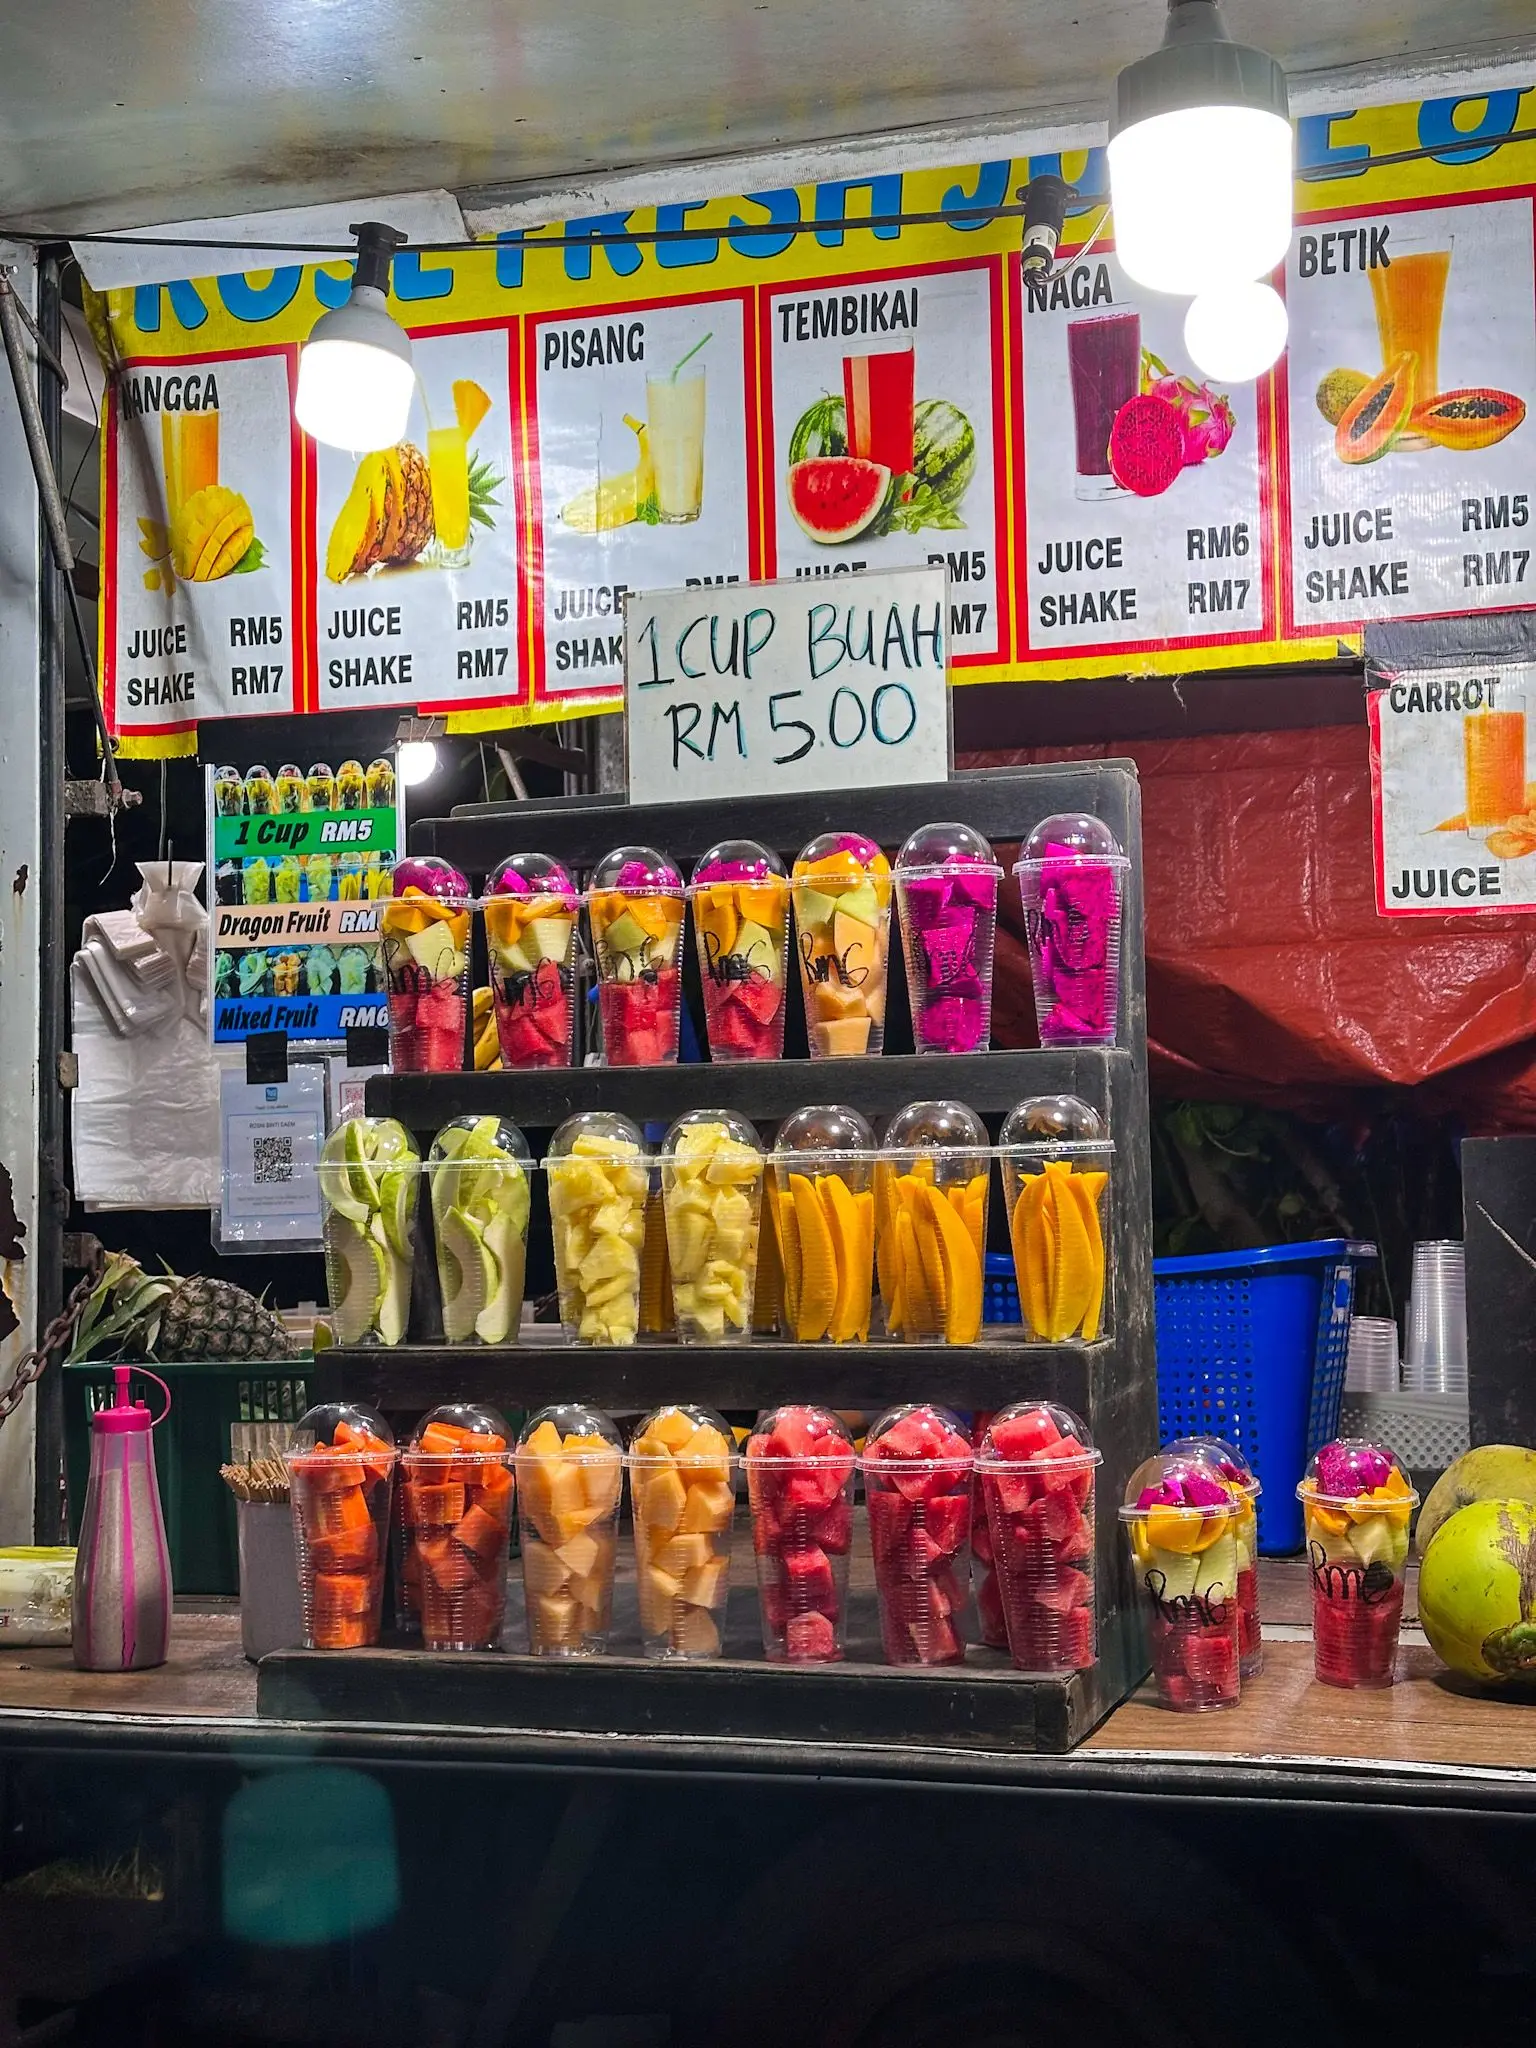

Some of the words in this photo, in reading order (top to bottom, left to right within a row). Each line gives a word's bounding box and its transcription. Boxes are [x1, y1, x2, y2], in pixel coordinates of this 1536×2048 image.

[1300, 225, 1391, 278] BETIK
[1028, 263, 1113, 313] NAGA
[778, 288, 918, 342] TEMBIKAI
[544, 322, 645, 370] PISANG
[1304, 507, 1393, 549] JUICE
[1461, 495, 1529, 532] RM5
[1038, 537, 1122, 574] JUICE
[1187, 523, 1250, 560] RM6
[1306, 561, 1409, 603] SHAKE
[1463, 550, 1530, 587] RM7
[327, 606, 401, 639] JUICE
[457, 599, 509, 631] RM5
[554, 585, 628, 620] JUICE
[951, 604, 987, 635] M7
[1040, 588, 1137, 627] SHAKE
[1188, 580, 1250, 614] RM7
[127, 624, 186, 658] JUICE
[230, 616, 282, 647] RM5
[556, 635, 624, 670] SHAK
[808, 602, 943, 680] BUAH
[127, 671, 195, 706] SHAKE
[231, 665, 283, 696] RM7
[328, 654, 412, 688] SHAKE
[457, 647, 509, 679] RM7
[1389, 678, 1500, 714] CARROT
[664, 701, 747, 770] RM
[769, 682, 917, 765] 5.00
[234, 820, 251, 845] 1
[257, 820, 309, 849] Cup
[321, 819, 373, 842] RM5
[1392, 866, 1501, 898] JUICE
[219, 914, 284, 941] Dragon
[286, 908, 330, 933] Fruit
[218, 1006, 271, 1031] Mixed
[273, 1003, 319, 1028] Fruit
